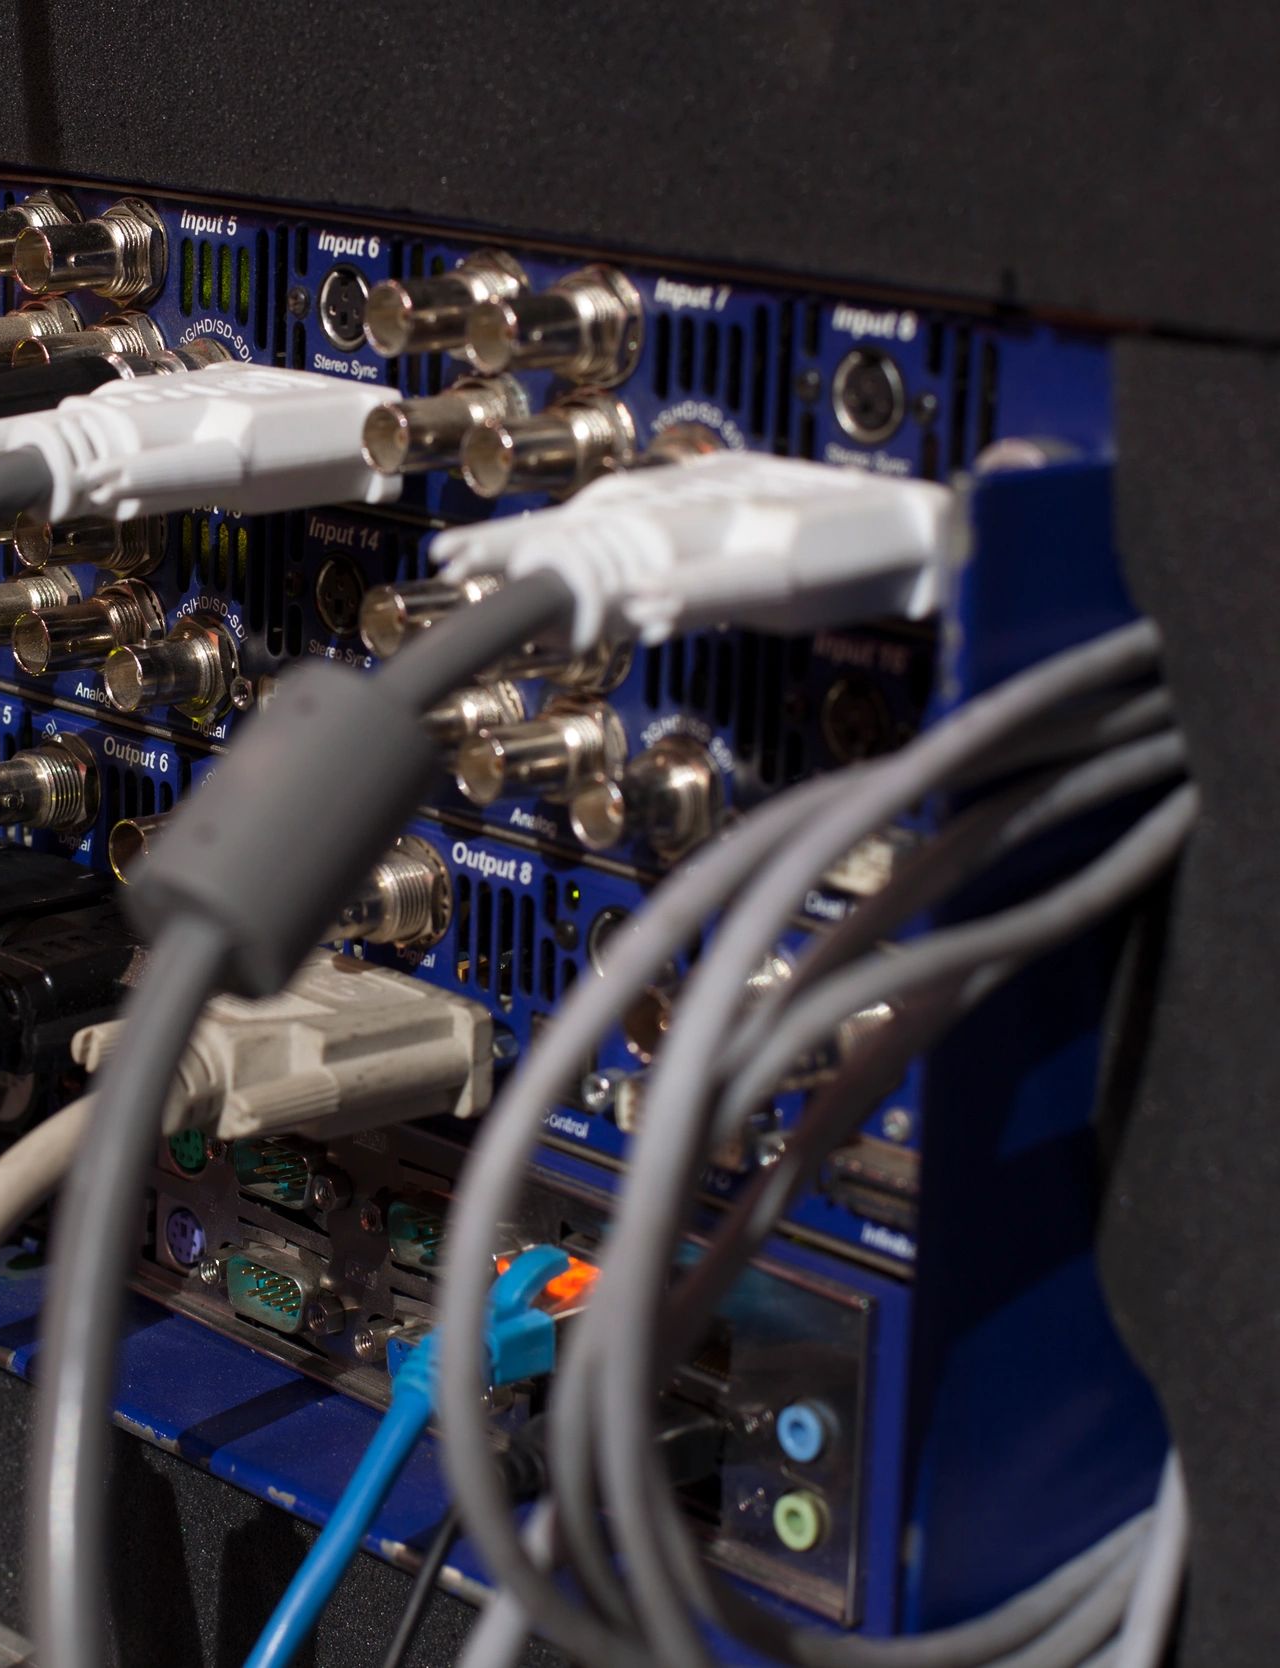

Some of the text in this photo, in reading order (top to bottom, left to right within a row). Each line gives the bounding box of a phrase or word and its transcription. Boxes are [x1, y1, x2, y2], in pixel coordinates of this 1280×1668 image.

[180, 209, 238, 236] Input 5
[318, 229, 380, 258] Input 6
[654, 275, 713, 311] Input
[313, 353, 378, 380] Stereo Sync
[308, 516, 380, 552] Input 14
[308, 638, 372, 668] Stereo Sync
[75, 681, 112, 708] Analog
[2, 705, 13, 725] 5
[191, 720, 226, 740] Digital
[104, 736, 169, 773] Output 6
[451, 841, 533, 886] Output 8
